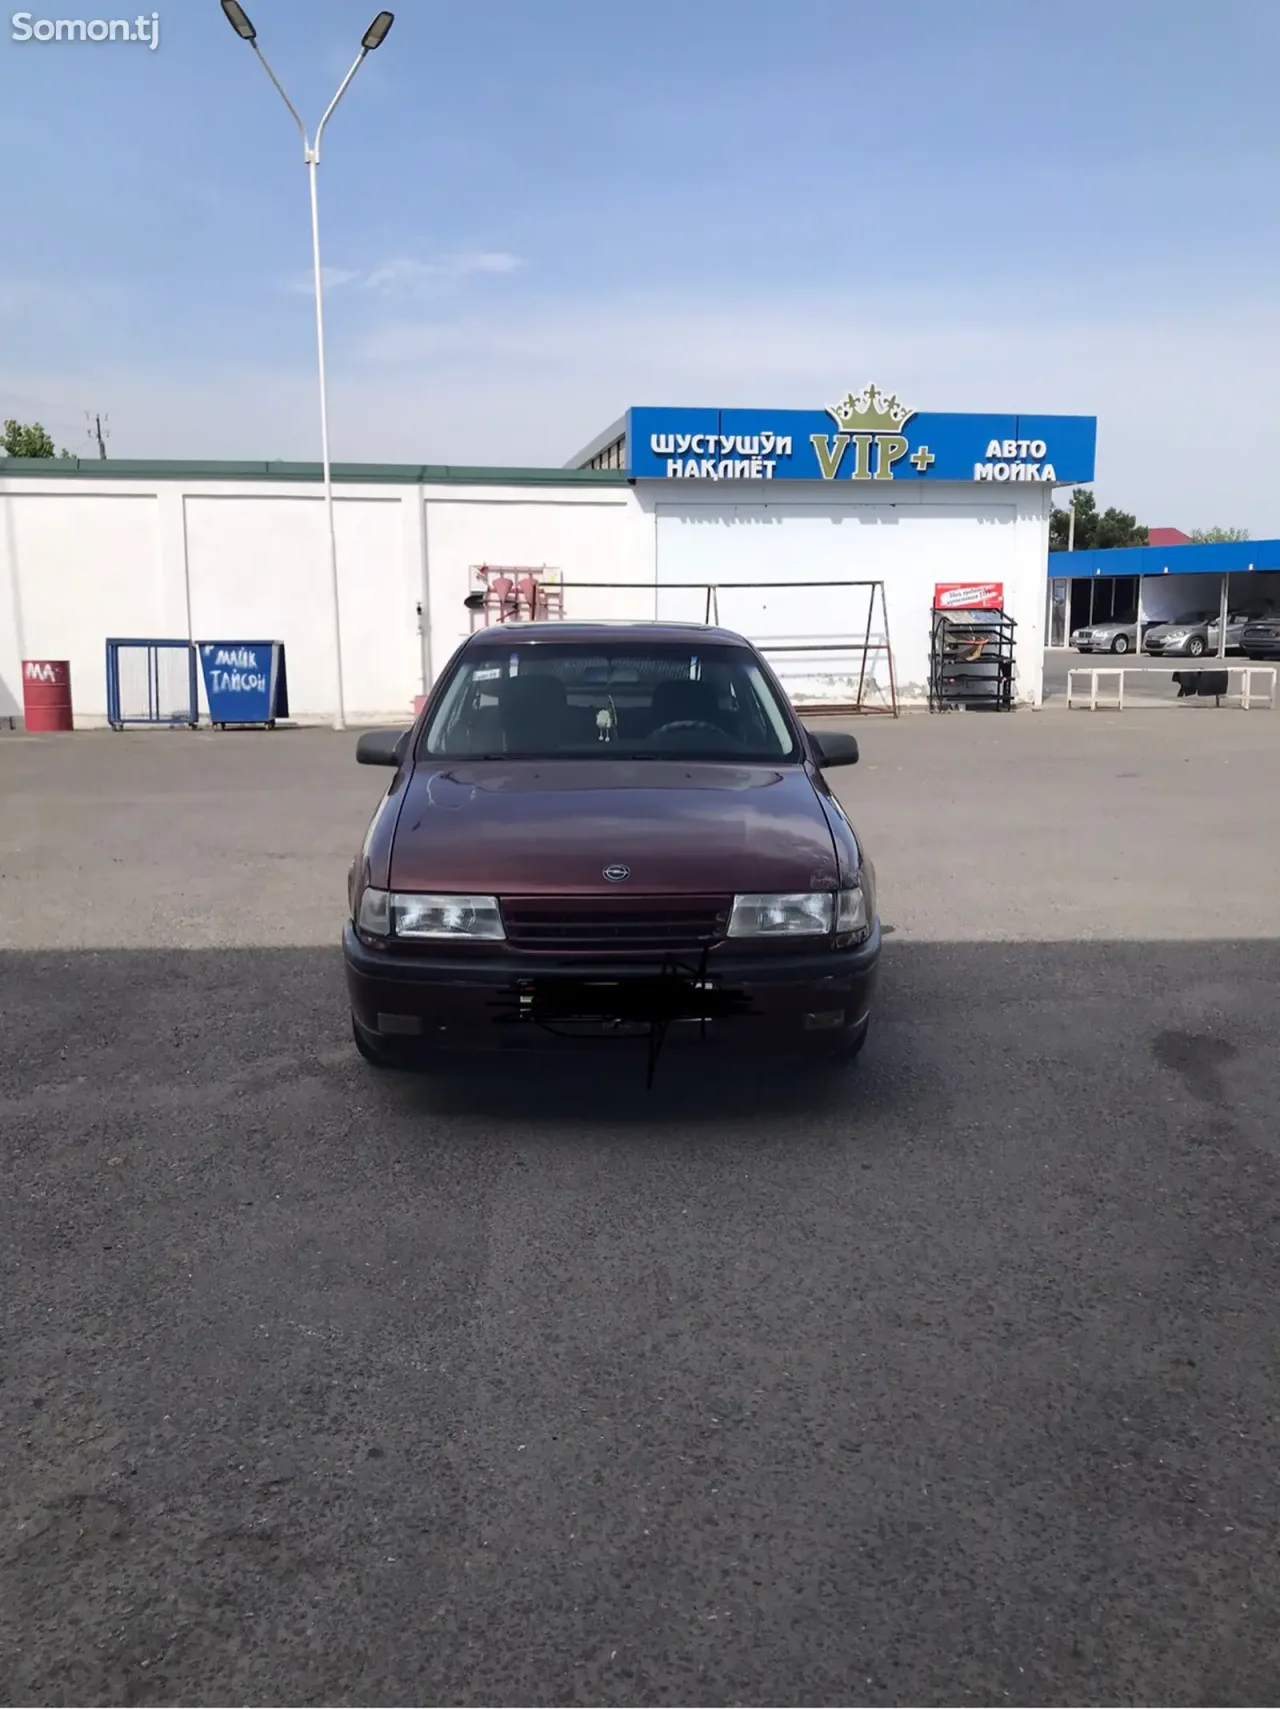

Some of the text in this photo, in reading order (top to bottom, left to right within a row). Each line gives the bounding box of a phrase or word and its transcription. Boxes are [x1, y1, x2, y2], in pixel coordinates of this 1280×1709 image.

[985, 440, 1047, 458] АВТО
[667, 456, 776, 481] НАҚЛИЁТ
[974, 460, 1057, 481] МОЙКА
[209, 668, 266, 694] ТАЙСОН
